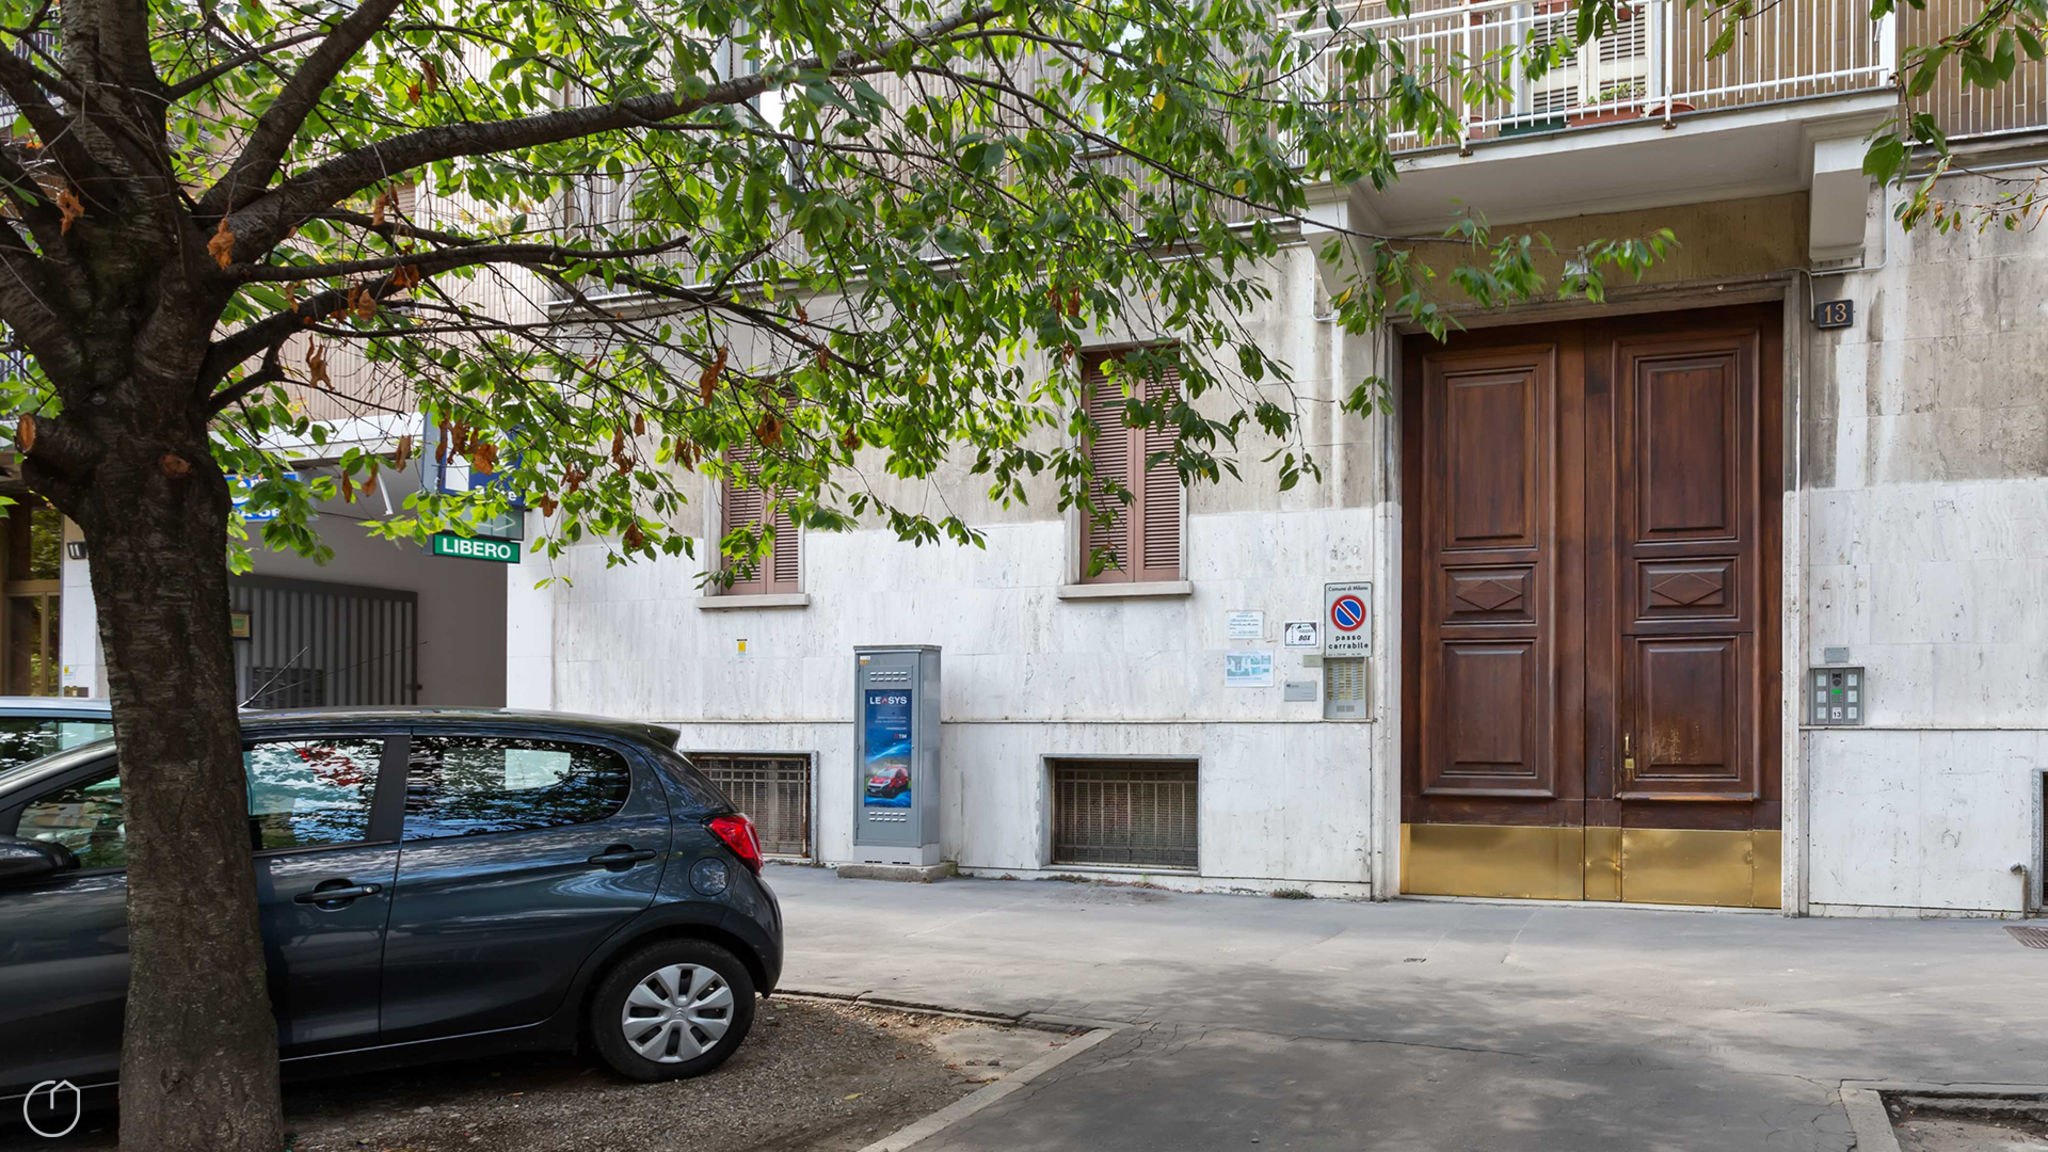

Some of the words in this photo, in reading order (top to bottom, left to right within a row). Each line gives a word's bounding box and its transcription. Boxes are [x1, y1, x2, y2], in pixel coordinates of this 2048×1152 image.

[1825, 303, 1847, 323] 13
[442, 538, 511, 559] LIBERO
[1328, 642, 1369, 650] carrabile
[869, 696, 907, 704] LEASYS
